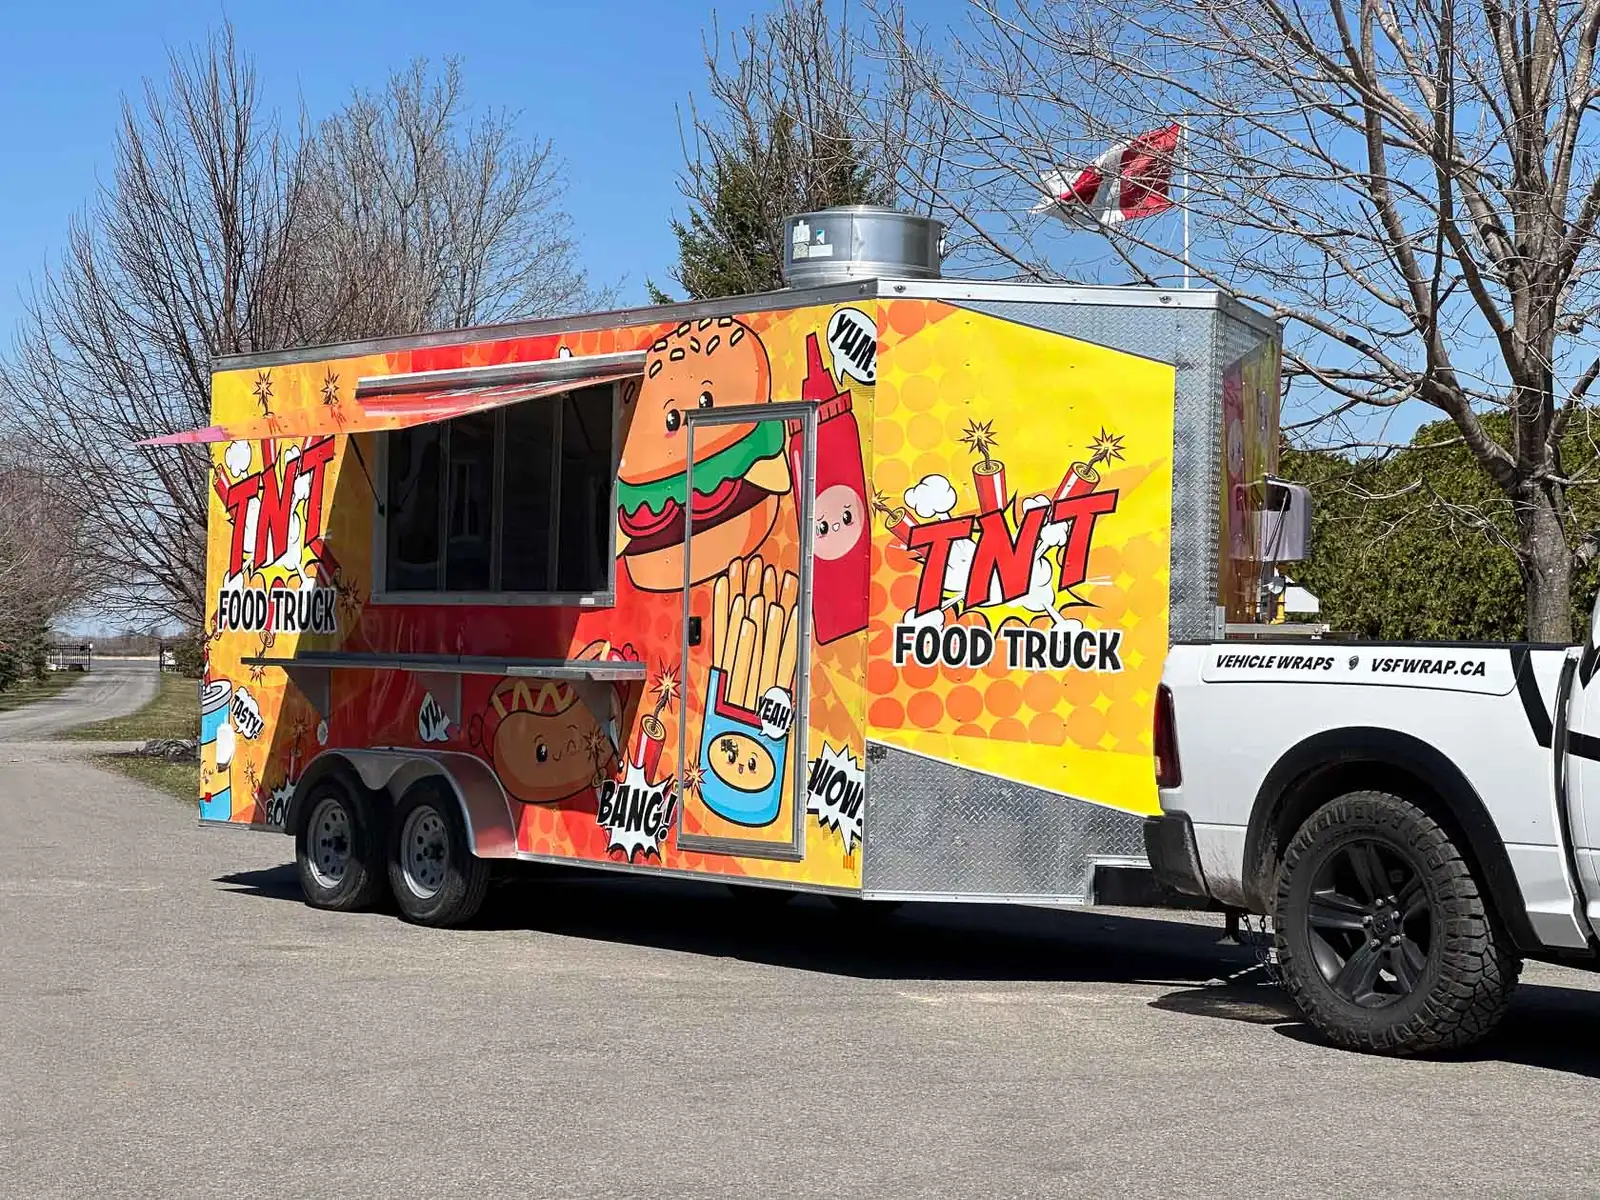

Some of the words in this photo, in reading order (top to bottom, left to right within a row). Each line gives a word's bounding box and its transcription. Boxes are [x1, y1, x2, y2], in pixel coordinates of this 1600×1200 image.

[227, 435, 335, 581] TNT
[907, 489, 1119, 618] TNT
[218, 590, 267, 630] FOOD
[273, 590, 336, 631] TRUCK
[896, 626, 993, 665] FOOD
[1004, 630, 1121, 671] TRUCK
[1215, 655, 1275, 669] VEHICLE
[1277, 657, 1335, 671] WRAPS
[1371, 659, 1486, 676] VSFWRAP.CA
[231, 695, 264, 739] TASTY!
[756, 695, 796, 732] YEAH!
[599, 781, 676, 839] BANG!
